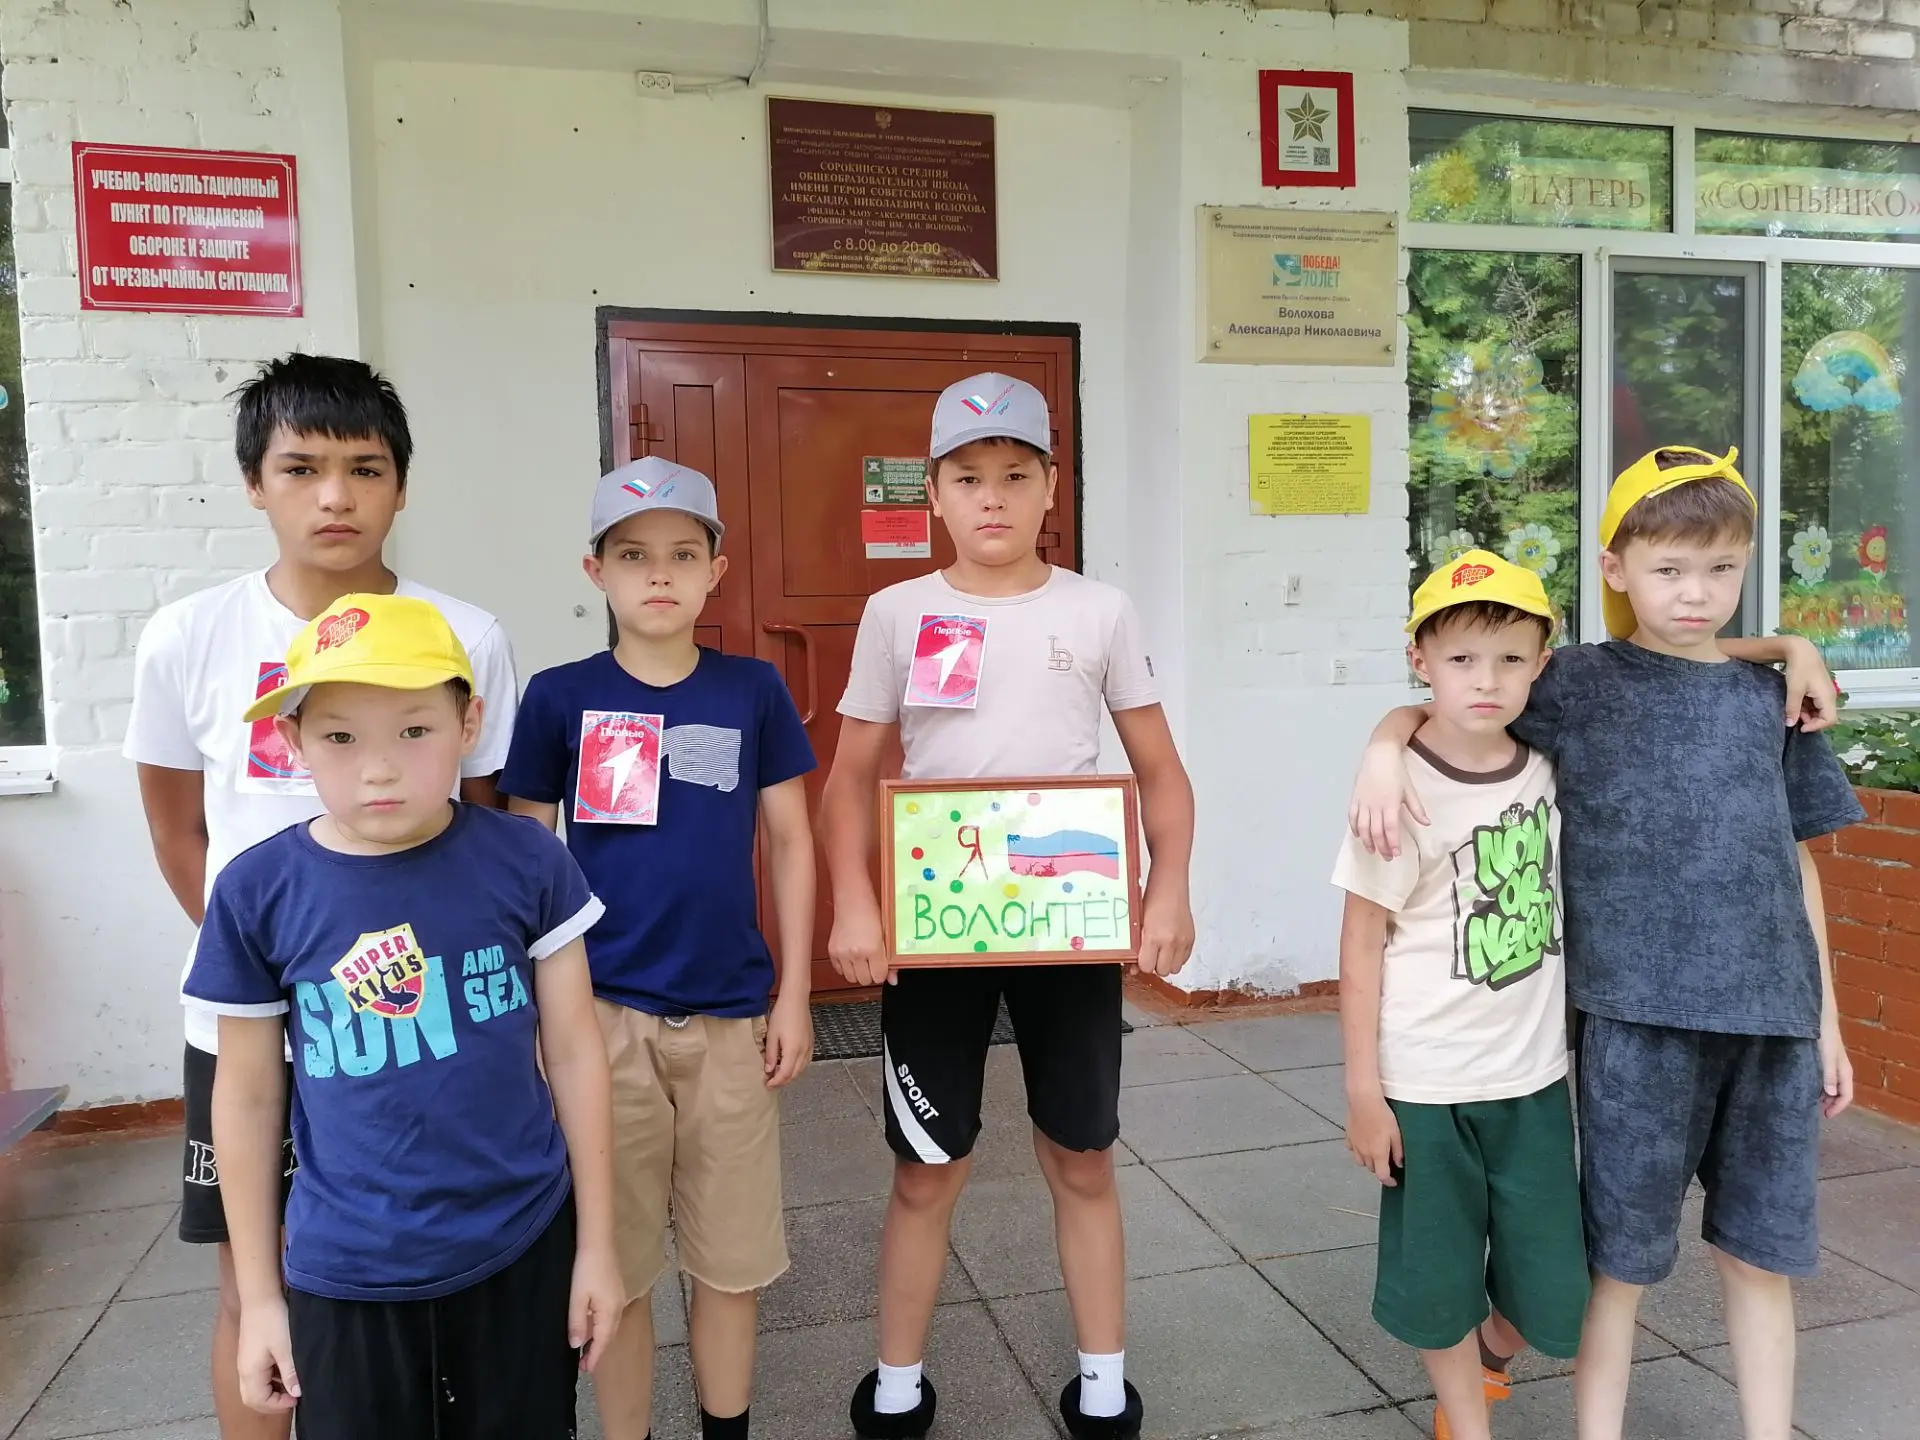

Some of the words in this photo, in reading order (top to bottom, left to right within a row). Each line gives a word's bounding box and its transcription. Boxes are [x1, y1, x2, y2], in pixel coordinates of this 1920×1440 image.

[91, 169, 279, 199] УЧЕБНО-КОНСУЛЬТАЦИОННЫЙ
[799, 171, 928, 188] ОБЩЕОБРАЗОВАТЕЛЬНАЯ
[932, 179, 969, 191] ШКОЛА
[820, 161, 898, 176] СОРОКИНСКАЯ
[902, 167, 949, 179] СРЕДНЯЯ
[782, 193, 849, 206] АЛЕКСАНДРА
[854, 197, 930, 210] НИКОЛАЕВИЧА
[934, 202, 987, 214] ВОЛОХОВА
[790, 182, 829, 193] ИМЕНИ
[833, 184, 866, 195] ГЕРОЯ
[870, 187, 938, 199] СОВЕТСКОГО
[942, 191, 978, 203] СОЮЗА
[1516, 173, 1646, 210] ЛАГЕРЬ
[1700, 180, 1920, 217] «СОЛНЫШКО»
[111, 202, 151, 224] ПУНКТ
[153, 204, 170, 225] ПО
[172, 206, 264, 230] ГРАЖДАНСКОЙ
[129, 235, 187, 257] ОБОРОНЕ
[189, 238, 197, 257] И
[199, 238, 250, 262] ЗАЩИТЕ
[833, 240, 842, 250] с
[845, 237, 876, 252] 8.00
[880, 242, 898, 255] до
[1302, 254, 1341, 269] ПОБЕДА!
[92, 266, 109, 287] ОТ
[110, 266, 217, 290] ЧРЕЗВЫЧАЙНЫХ
[218, 271, 288, 294] СИТУАЦИЯХ
[1302, 270, 1317, 287] 70
[1318, 270, 1341, 288] ЛЕТ
[1278, 306, 1335, 320] Волохова
[1228, 322, 1301, 338] Александра
[1304, 324, 1382, 339] Николаевича
[933, 625, 972, 636] Первые
[600, 727, 645, 739] Первые
[957, 825, 989, 881] Я
[914, 891, 1129, 940] ВОЛОНТЁР
[341, 935, 409, 984] SUPER
[462, 945, 505, 977] AND
[349, 953, 423, 1009] KIDS
[463, 965, 528, 1023] SEA
[295, 955, 458, 1079] SUN
[897, 1063, 940, 1121] SPORT
